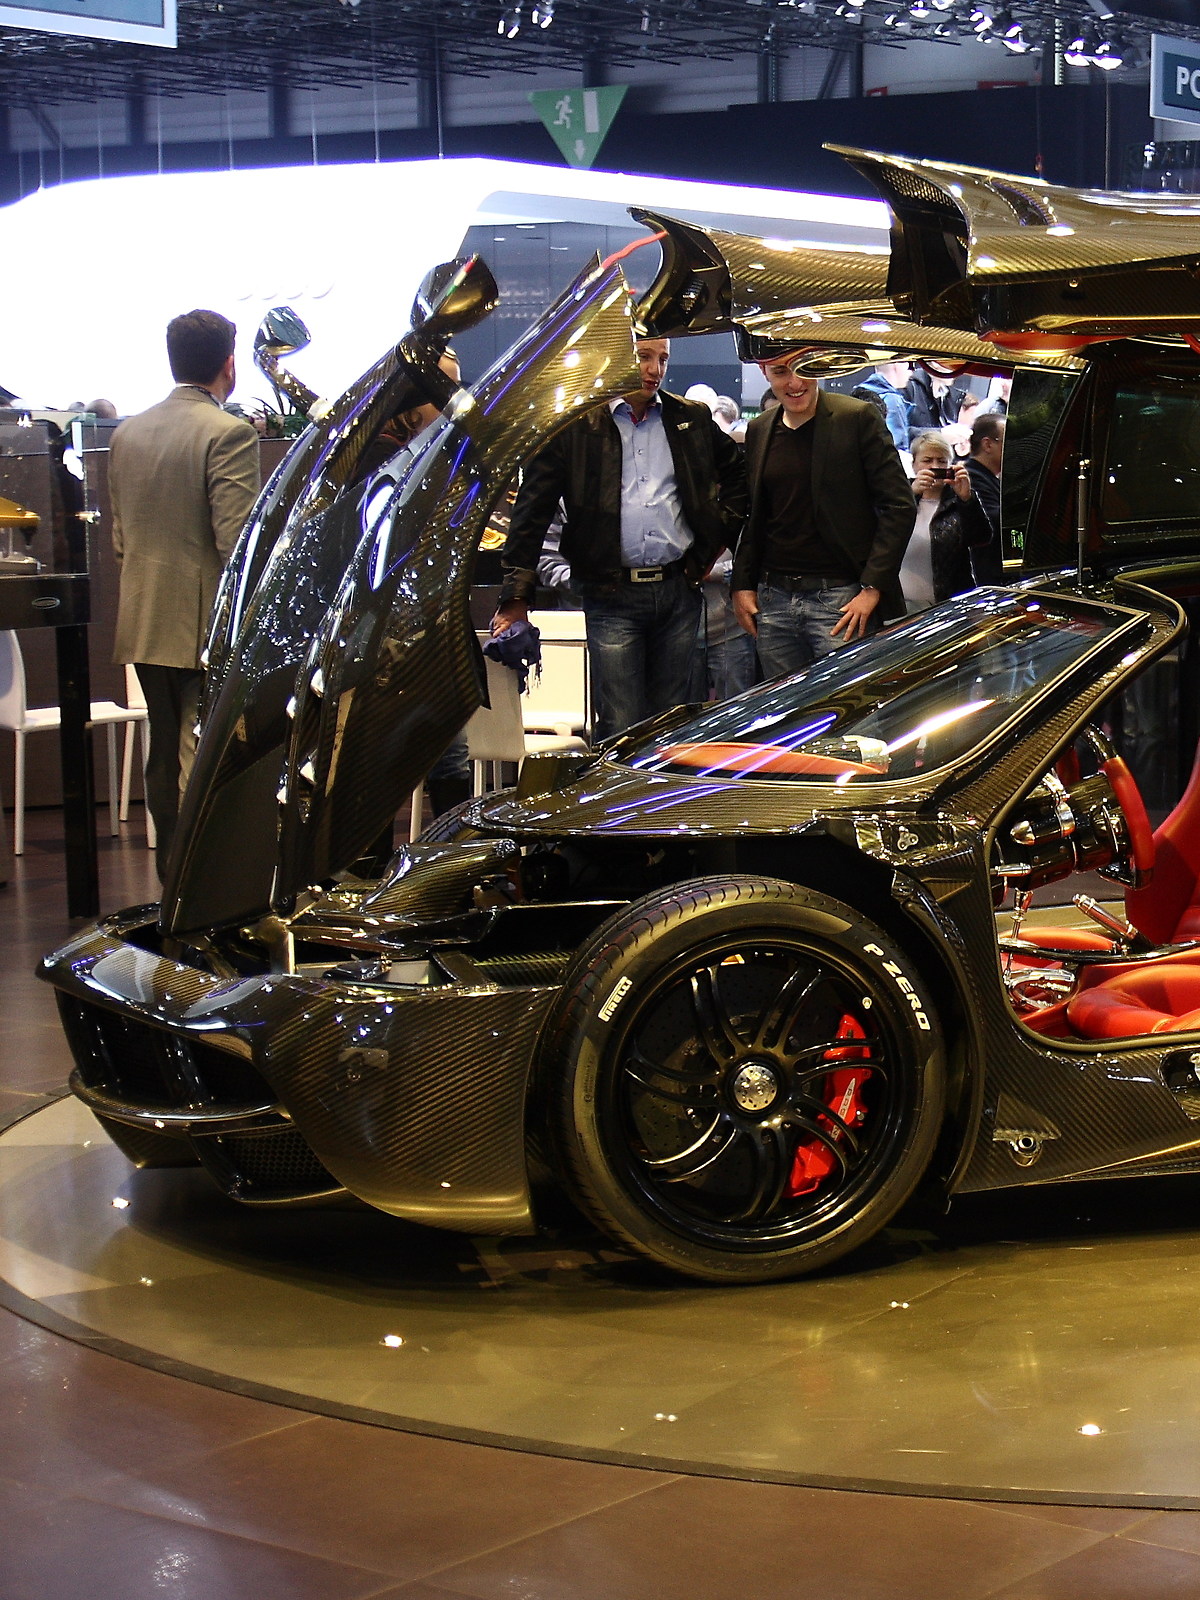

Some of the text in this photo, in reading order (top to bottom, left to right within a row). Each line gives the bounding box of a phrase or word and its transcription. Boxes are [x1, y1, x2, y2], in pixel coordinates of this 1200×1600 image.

[597, 975, 633, 1022] PIRELLI
[863, 943, 931, 1031] P ZERO
